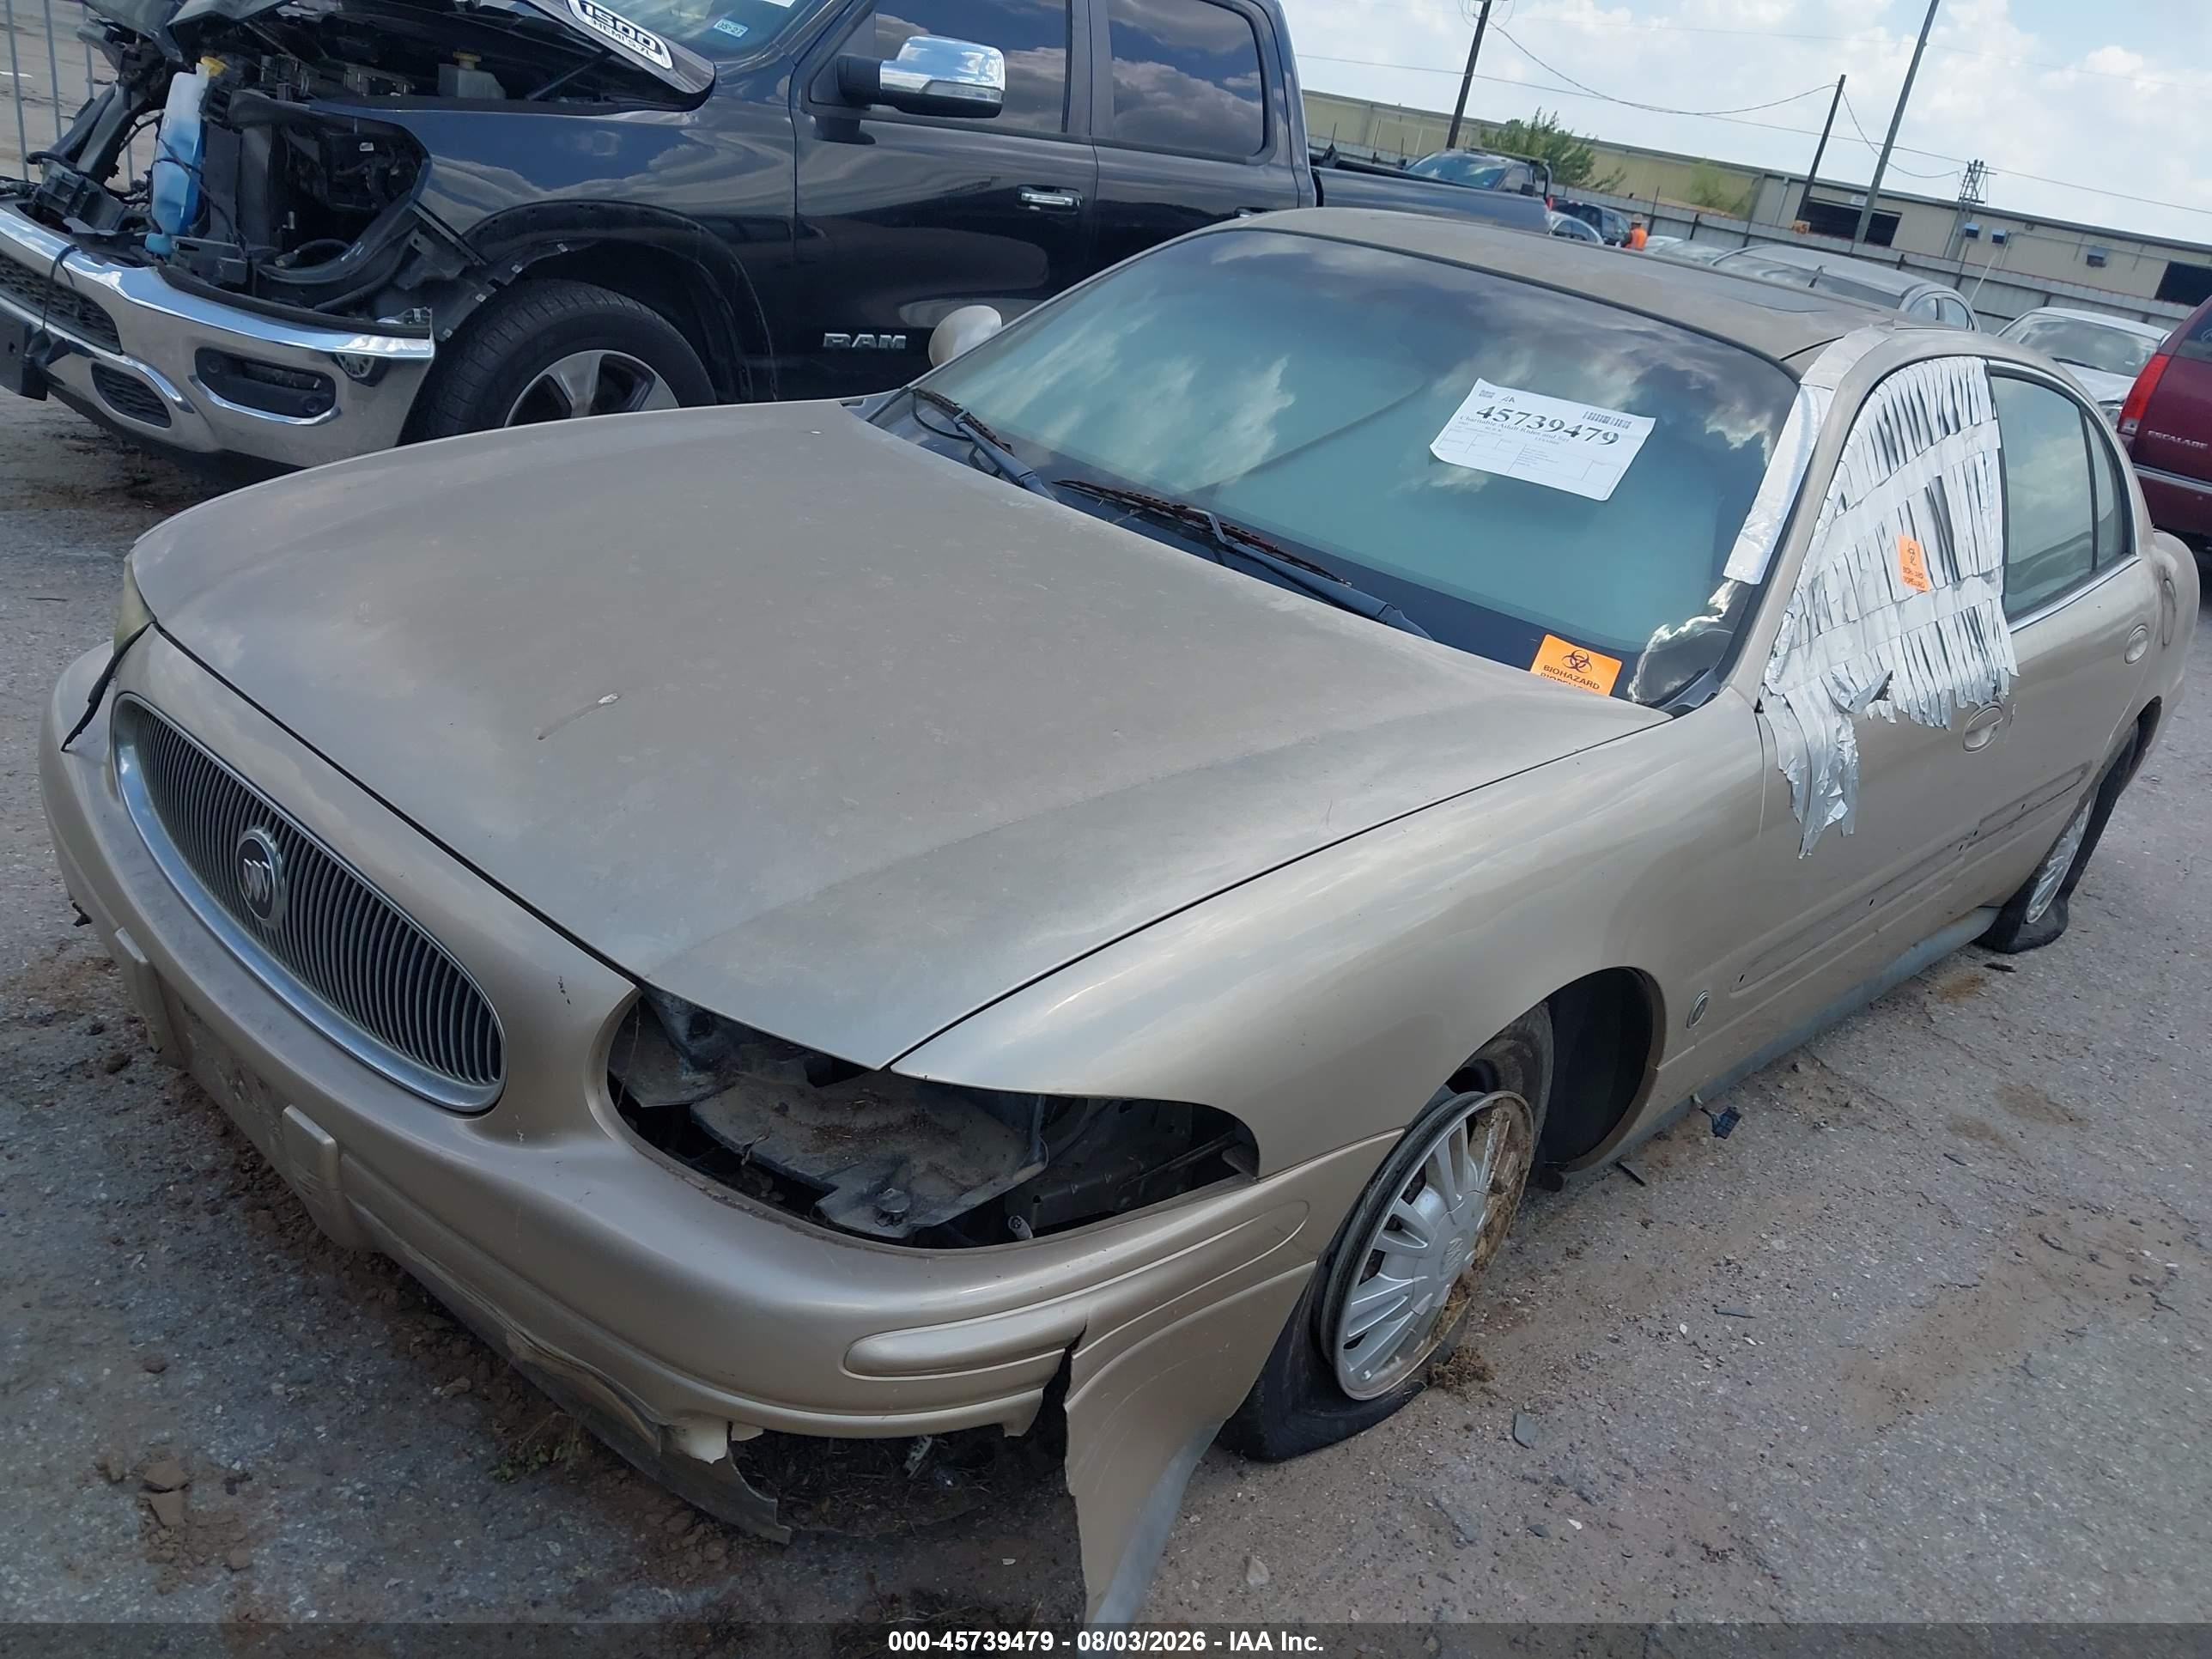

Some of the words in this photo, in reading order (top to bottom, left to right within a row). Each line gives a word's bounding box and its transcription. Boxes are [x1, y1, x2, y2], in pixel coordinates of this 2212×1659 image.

[581, 3, 656, 51] 1500
[592, 18, 626, 42] HEMI
[823, 332, 907, 349] RAM
[1476, 405, 1620, 446] 45739479
[2148, 430, 2208, 449] ESCALADE
[1543, 665, 1600, 690] BIOHAZARD
